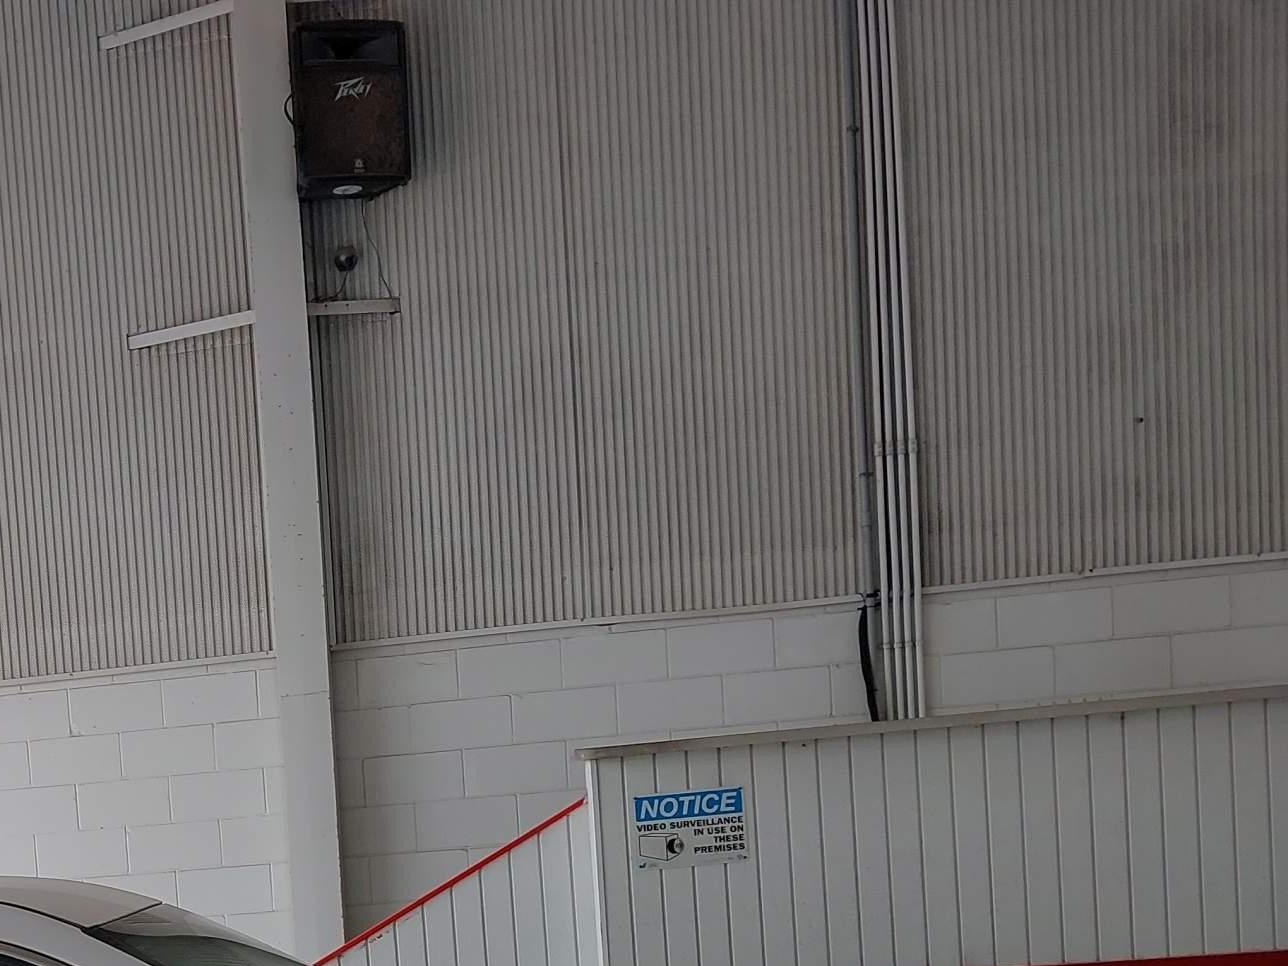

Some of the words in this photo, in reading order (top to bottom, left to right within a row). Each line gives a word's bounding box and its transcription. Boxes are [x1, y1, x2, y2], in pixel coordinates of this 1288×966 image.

[639, 791, 737, 820] NOTICE
[637, 822, 666, 832] VIDEO
[669, 815, 744, 830] SURVEILLANCE
[693, 828, 704, 836] IN
[707, 826, 727, 835] USE
[730, 825, 744, 833] ON
[714, 834, 745, 844] THESE
[693, 842, 746, 854] PREMISES
